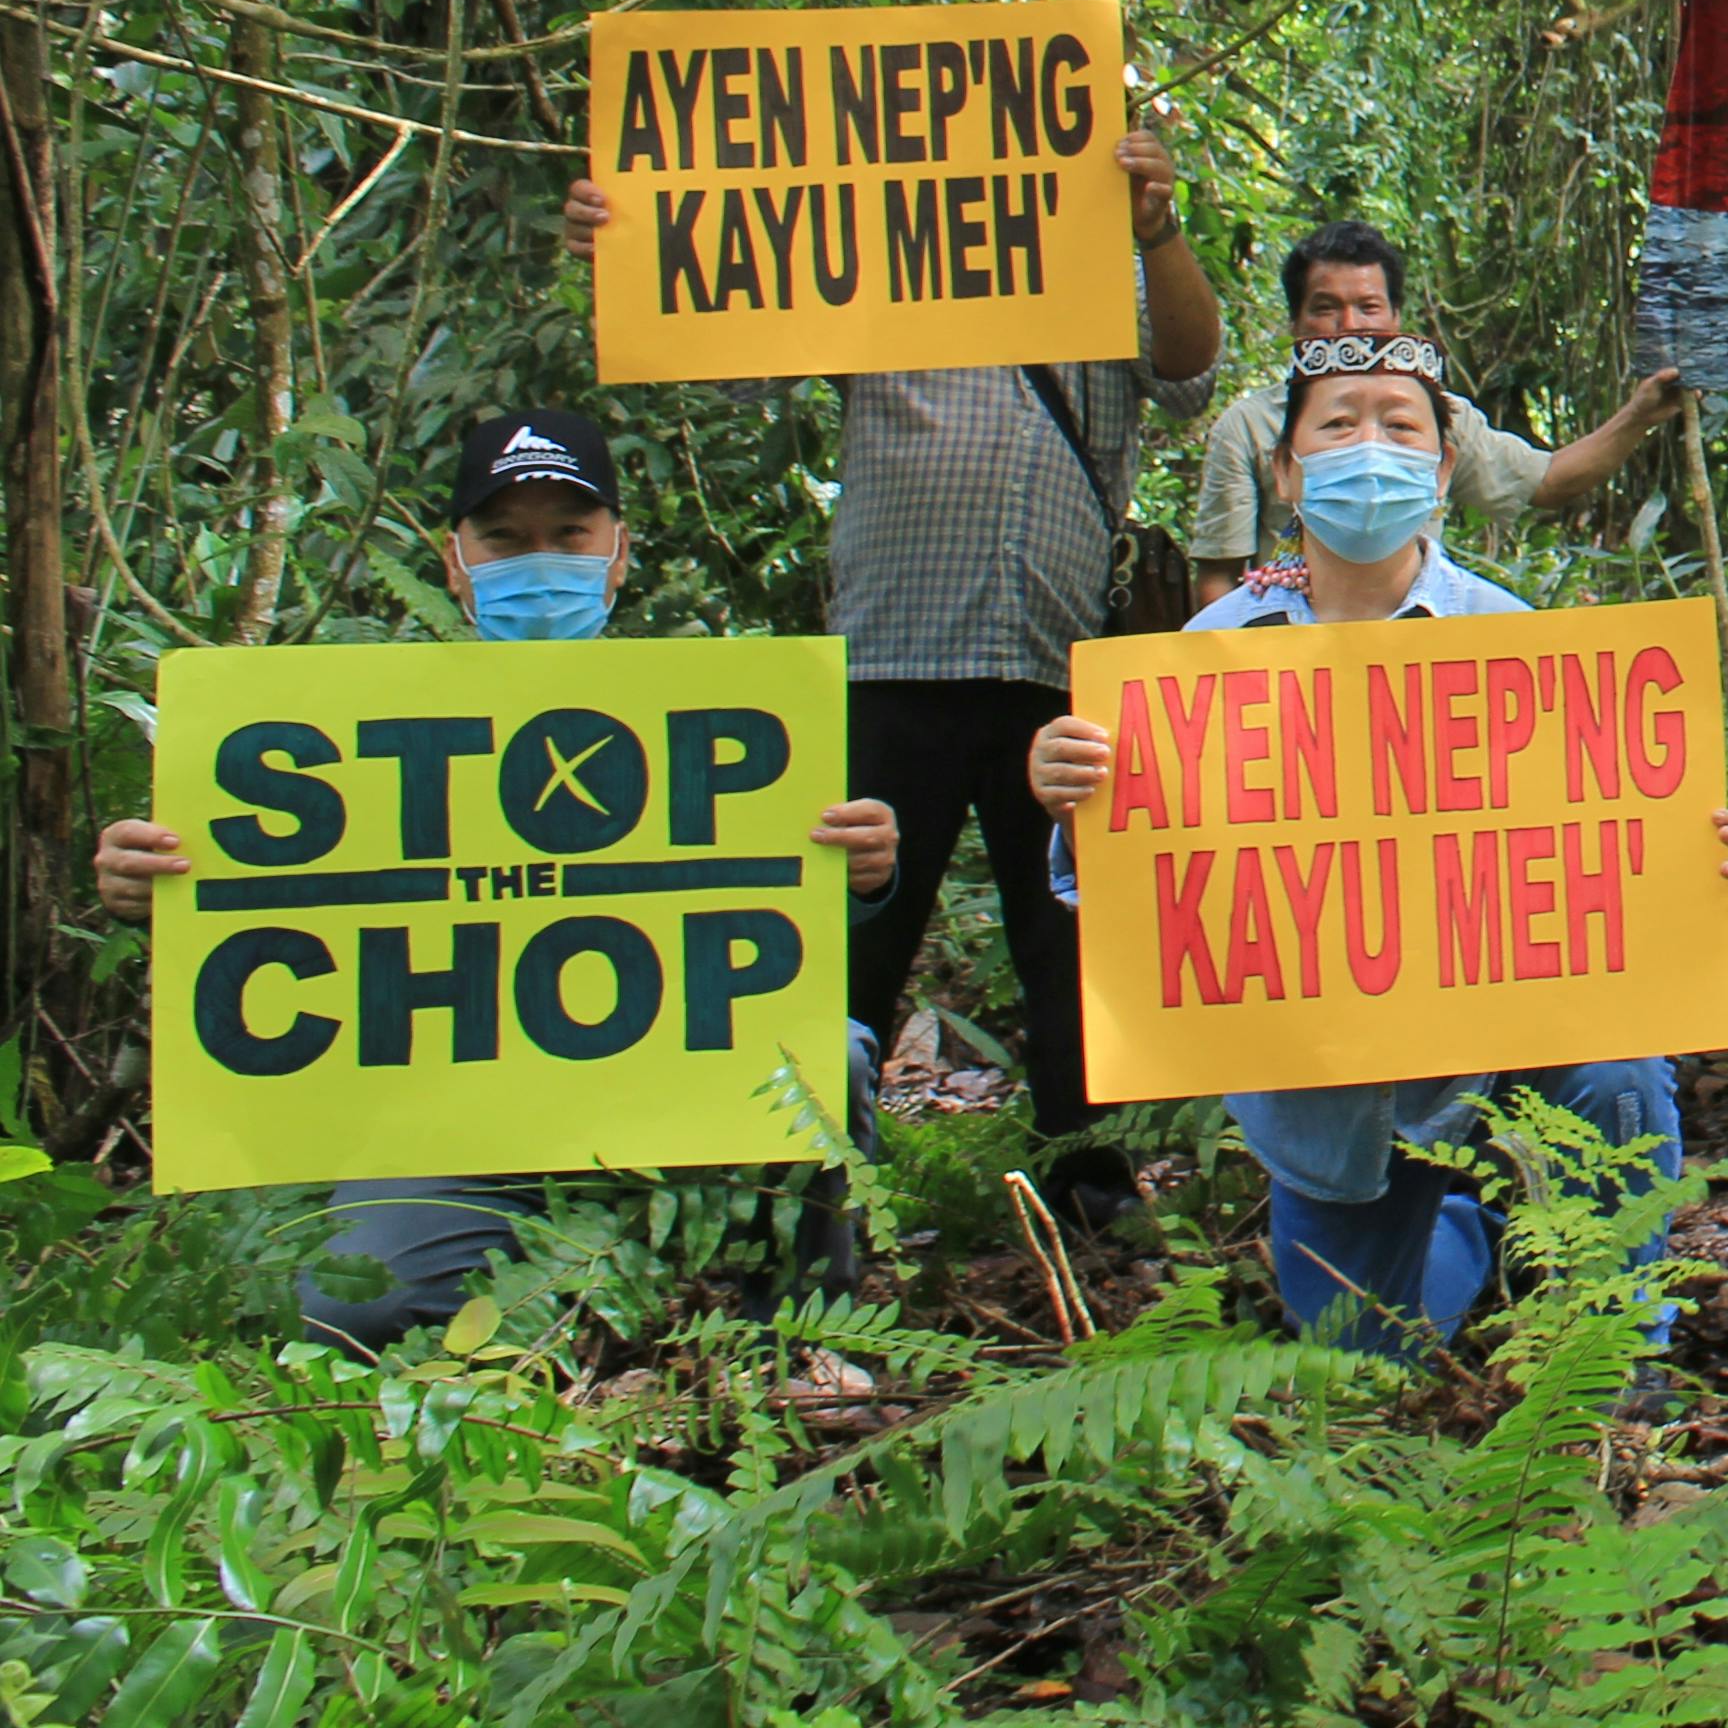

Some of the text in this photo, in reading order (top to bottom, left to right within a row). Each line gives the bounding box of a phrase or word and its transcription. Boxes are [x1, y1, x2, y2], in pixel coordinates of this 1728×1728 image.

[618, 34, 1093, 172] AYEN NEP'NG
[657, 172, 1058, 314] KAYU MEH'
[209, 708, 790, 865] STOP
[1110, 646, 1686, 833] AYEN NEP'NG
[456, 862, 556, 901] THE
[1155, 818, 1644, 1008] KAYU MEH'
[194, 908, 803, 1076] CHOP
